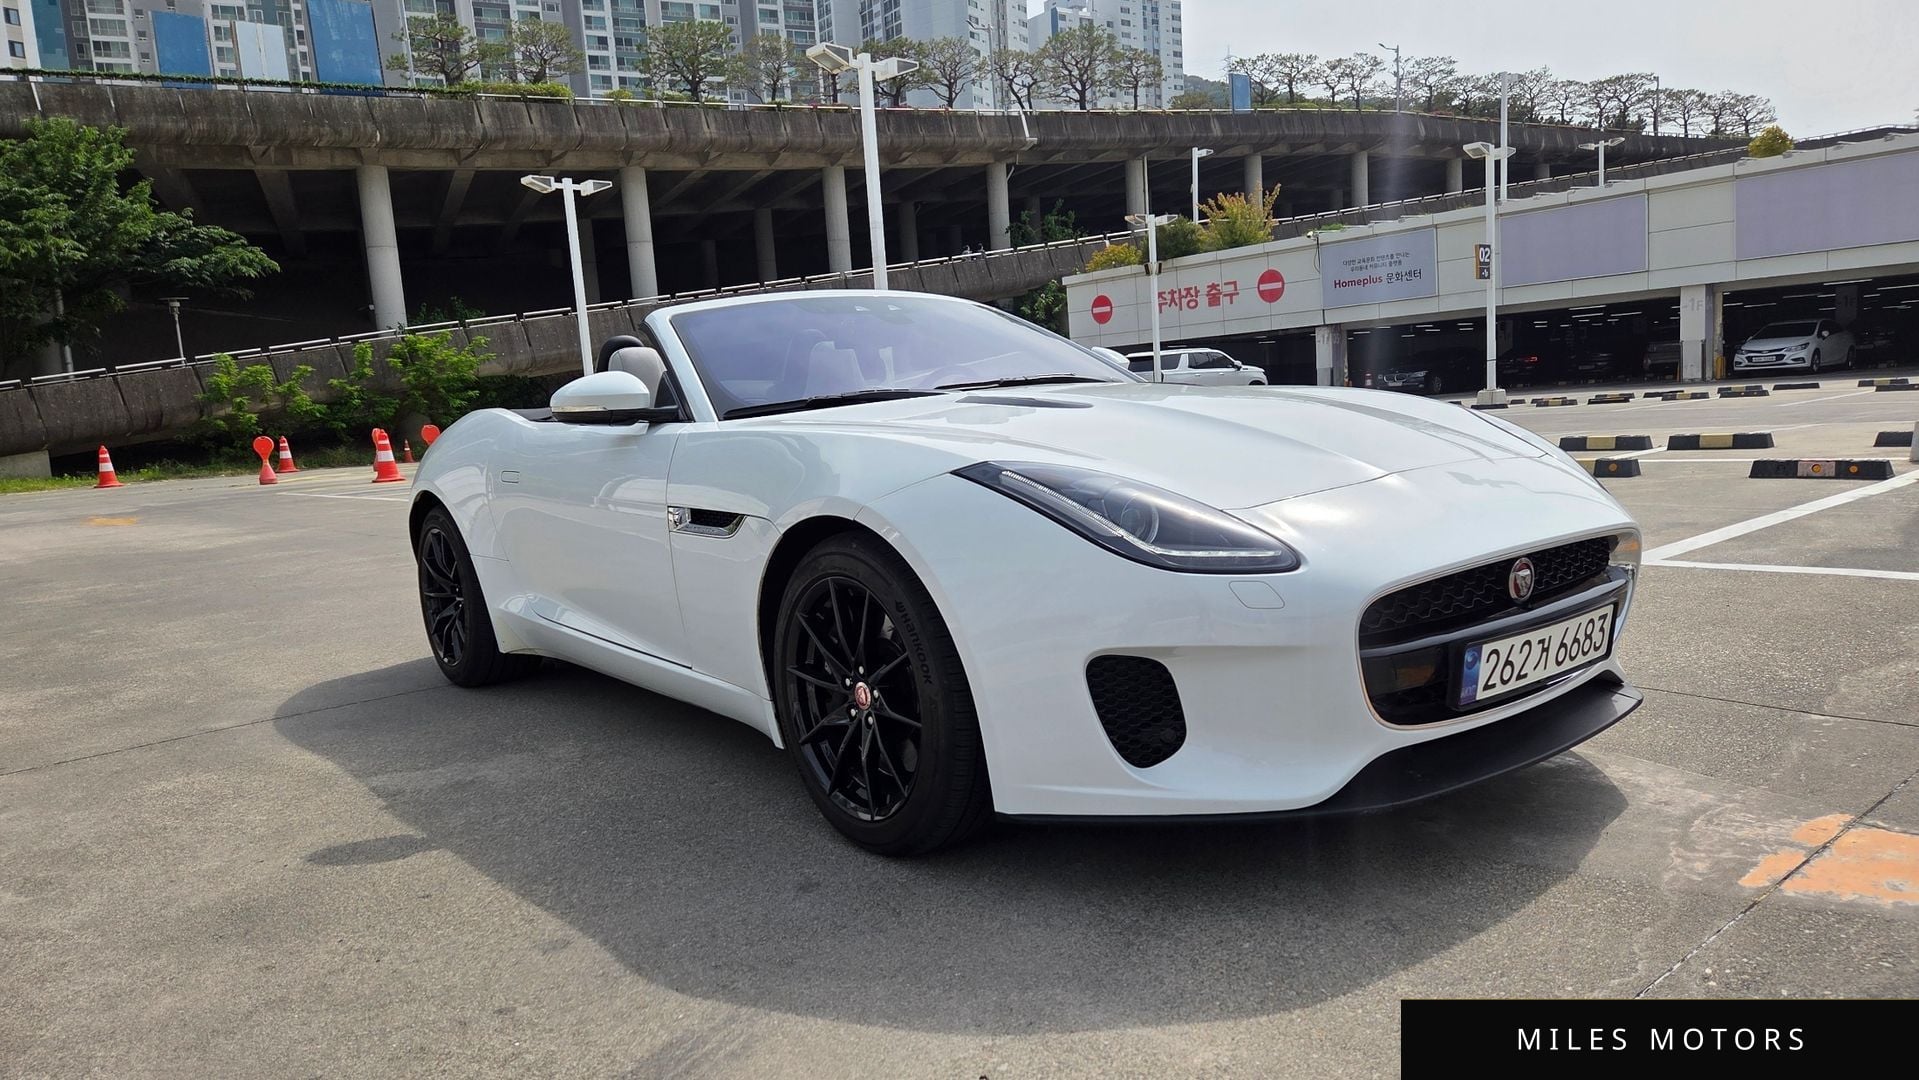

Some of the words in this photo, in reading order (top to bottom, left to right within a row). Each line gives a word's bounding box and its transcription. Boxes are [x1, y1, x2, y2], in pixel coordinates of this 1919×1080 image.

[1479, 247, 1490, 262] 02
[1333, 274, 1383, 289] Homeplus
[1385, 268, 1422, 284] 문화센터
[1206, 280, 1240, 308] 출구
[1482, 635, 1552, 692] 262거
[1554, 612, 1609, 667] 6683
